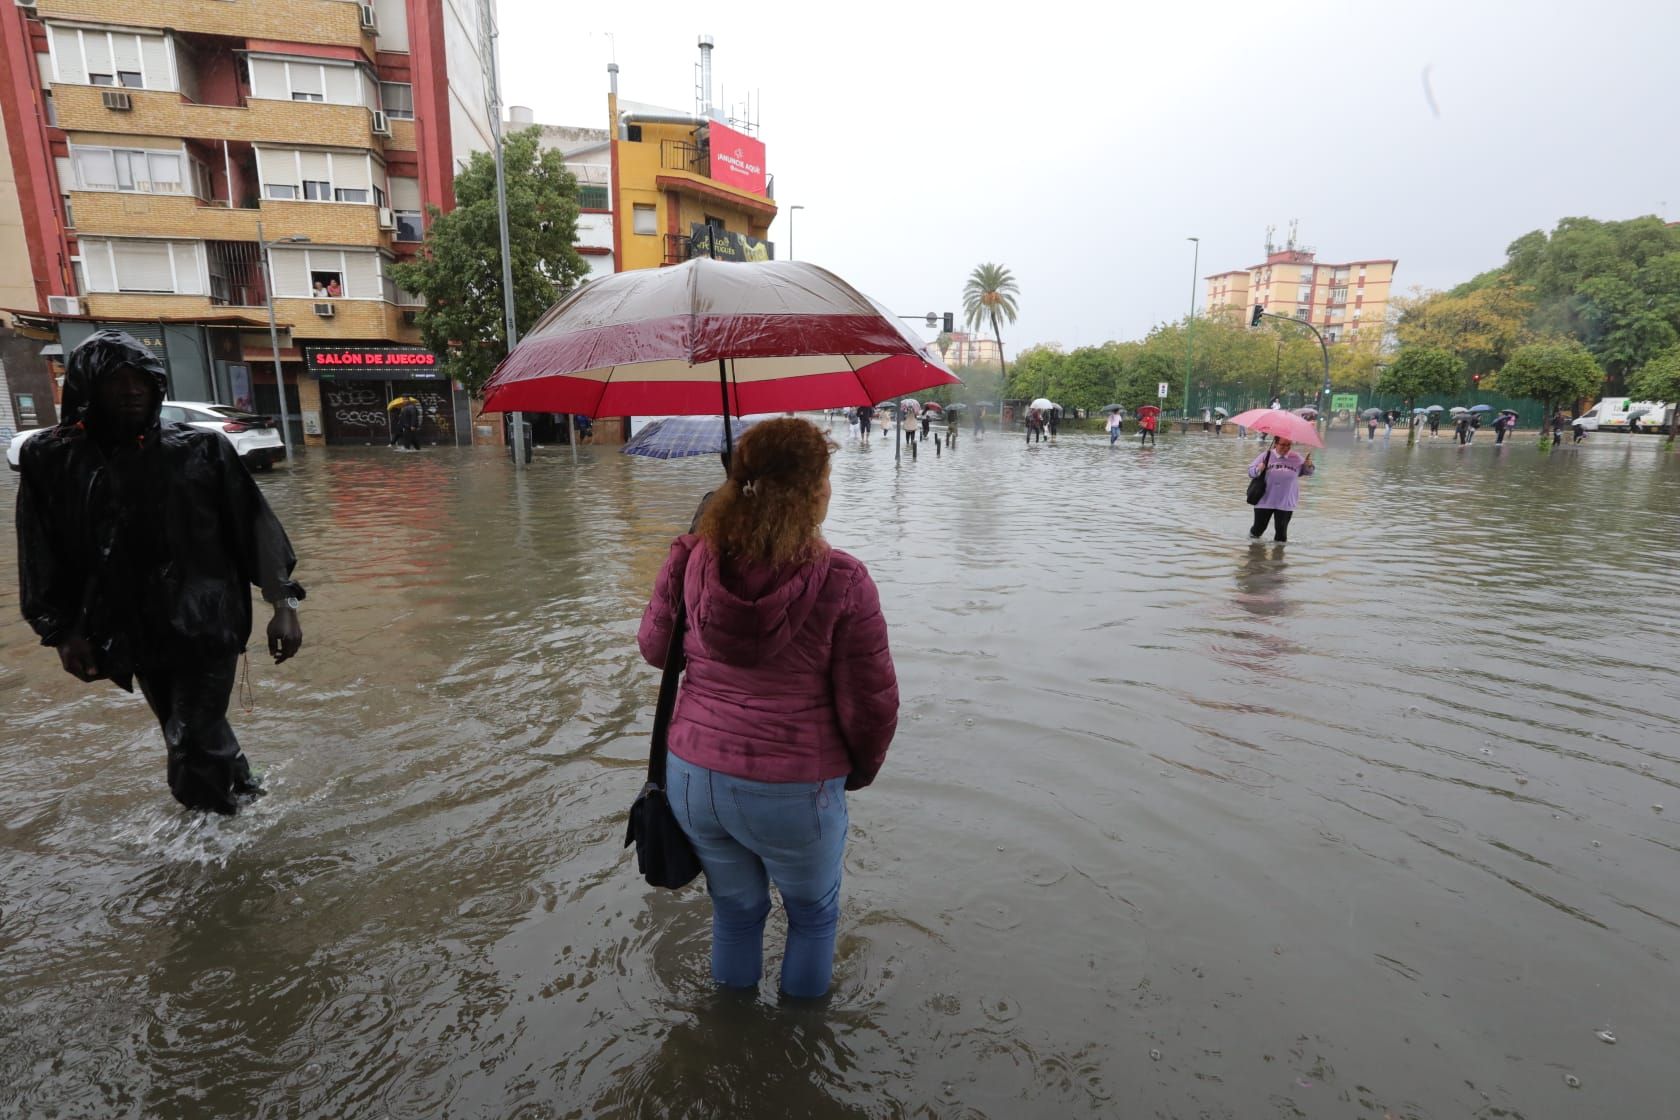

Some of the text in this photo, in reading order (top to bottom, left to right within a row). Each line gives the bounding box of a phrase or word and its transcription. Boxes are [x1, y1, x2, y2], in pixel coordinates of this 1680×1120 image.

[316, 351, 435, 364] SALÓN DE JUEGOS
